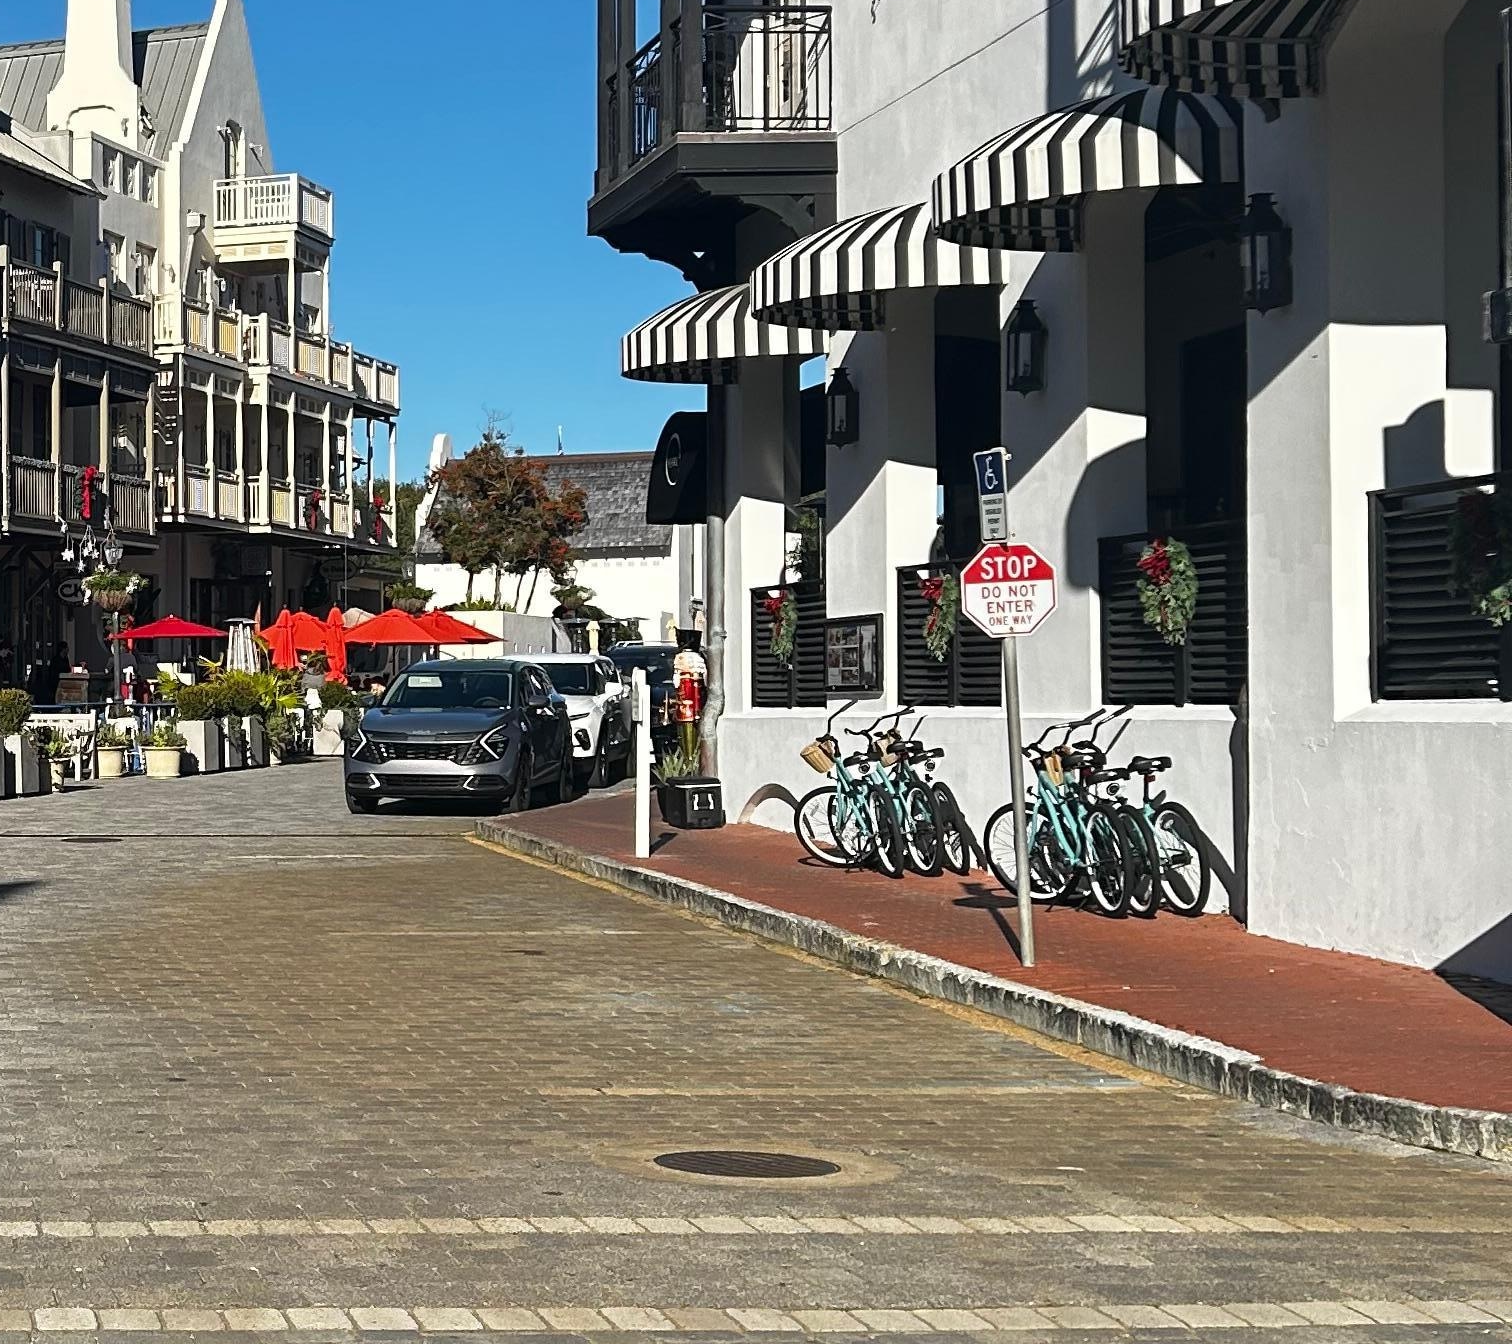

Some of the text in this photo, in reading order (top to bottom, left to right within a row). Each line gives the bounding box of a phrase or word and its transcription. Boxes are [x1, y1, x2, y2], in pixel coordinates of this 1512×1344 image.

[980, 555, 1037, 581] STOP
[981, 584, 1038, 600] DO NOT
[987, 600, 1034, 614] ENTER
[989, 614, 1033, 626] ONE WAY
